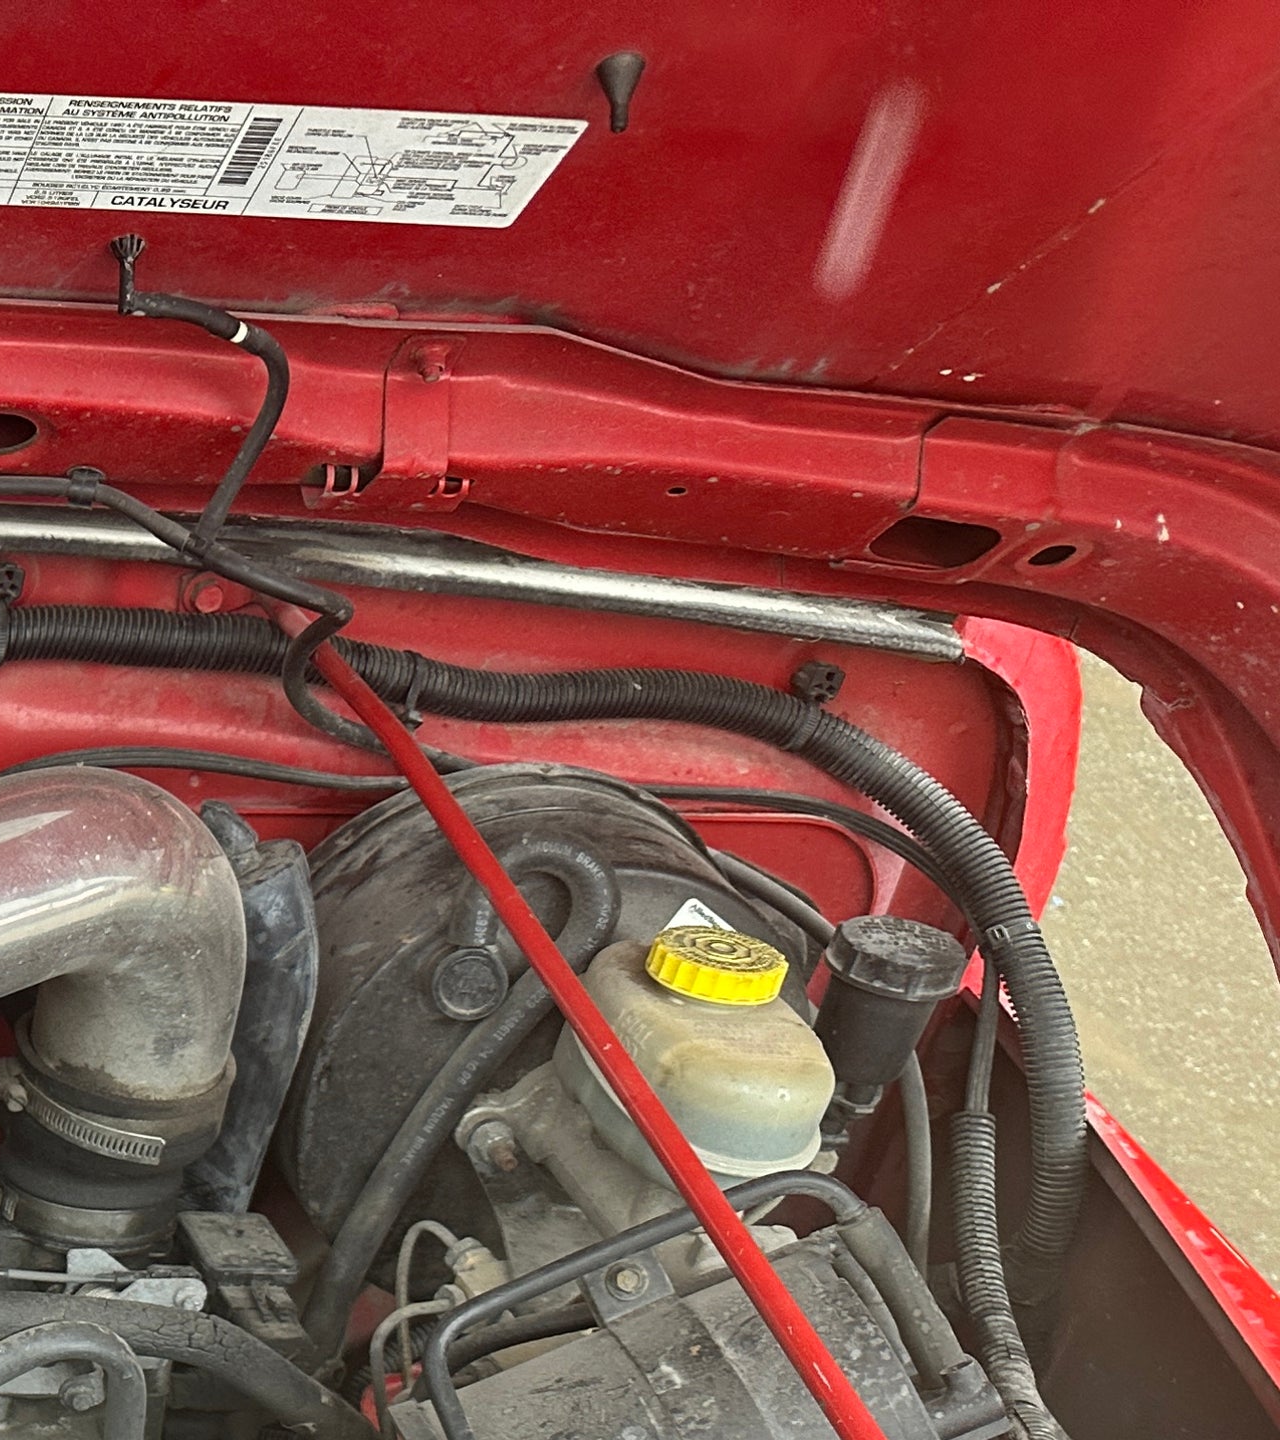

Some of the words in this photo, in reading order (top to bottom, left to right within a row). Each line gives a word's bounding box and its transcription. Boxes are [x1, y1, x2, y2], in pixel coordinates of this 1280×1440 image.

[68, 99, 176, 111] RENSEIGNEMENTS
[178, 103, 233, 113] RELATIFS
[62, 108, 79, 116] AU
[140, 111, 230, 122] ANTIPOLLUTION
[110, 195, 230, 210] CATALYSEUR
[576, 852, 606, 881] BRAKE
